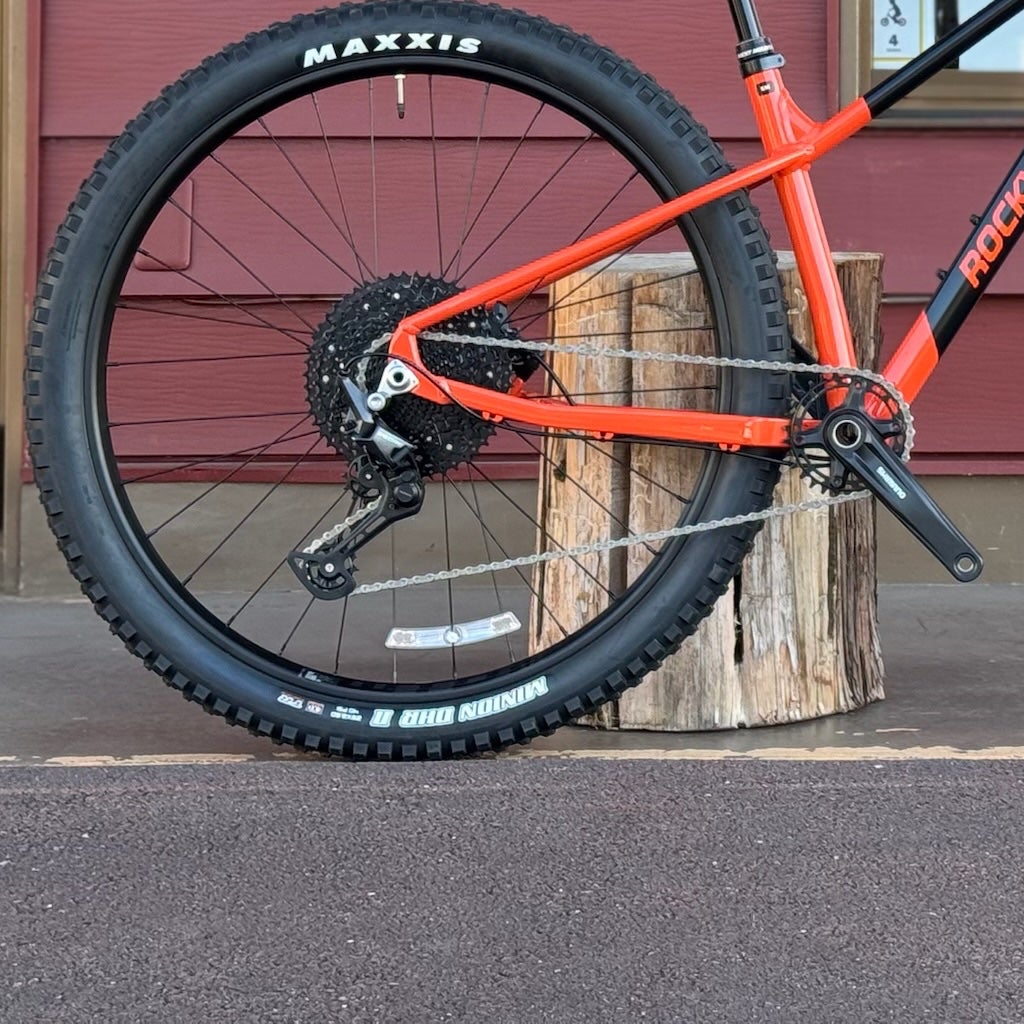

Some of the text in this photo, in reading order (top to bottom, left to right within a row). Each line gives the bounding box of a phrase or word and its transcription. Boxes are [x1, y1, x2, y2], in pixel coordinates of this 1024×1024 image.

[303, 33, 482, 69] MAXXIS
[888, 33, 899, 47] 4
[458, 675, 549, 723] MINION
[399, 705, 455, 728] DHR
